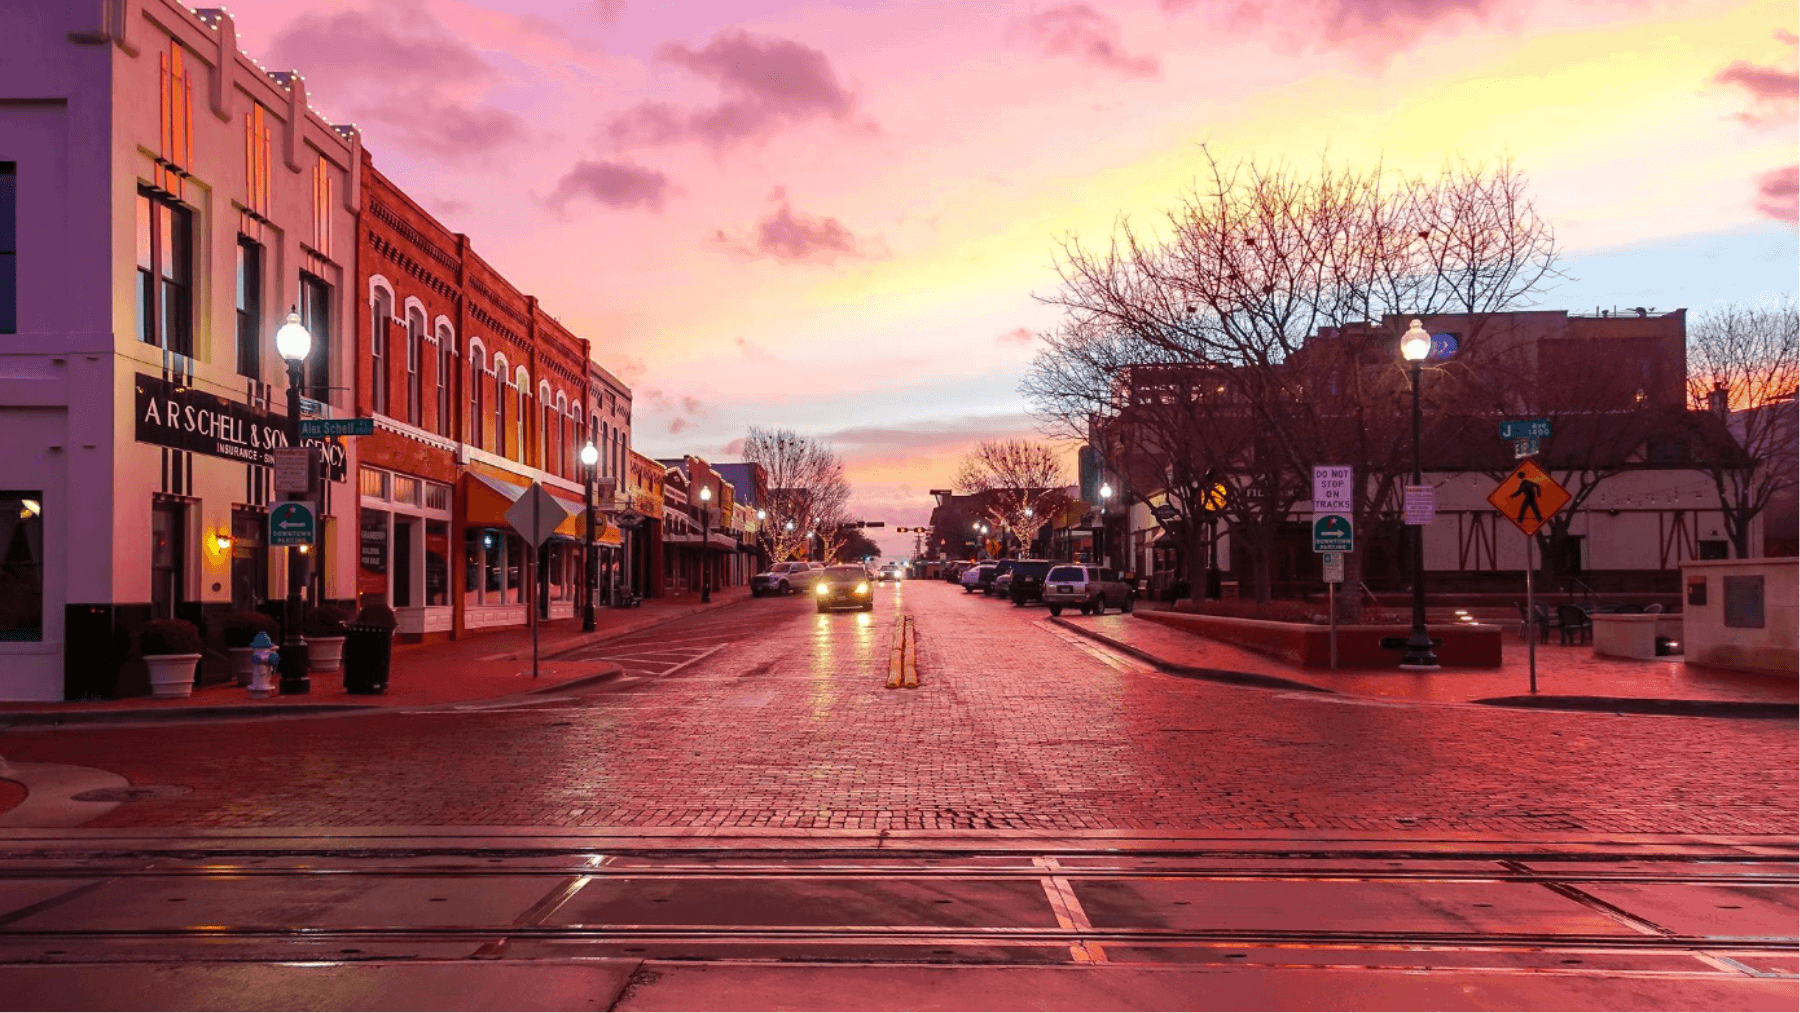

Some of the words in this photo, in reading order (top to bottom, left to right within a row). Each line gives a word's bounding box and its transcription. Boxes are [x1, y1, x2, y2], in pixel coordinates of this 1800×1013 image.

[302, 422, 321, 435] Alex
[323, 421, 355, 435] Schell
[1502, 423, 1512, 437] J
[250, 423, 260, 448] &
[216, 442, 258, 461] INSURANCE
[1316, 470, 1328, 478] DO
[1331, 469, 1349, 478] NOT
[1321, 480, 1344, 488] STOP
[1326, 490, 1340, 498] ON
[1315, 500, 1350, 508] TRACKS
